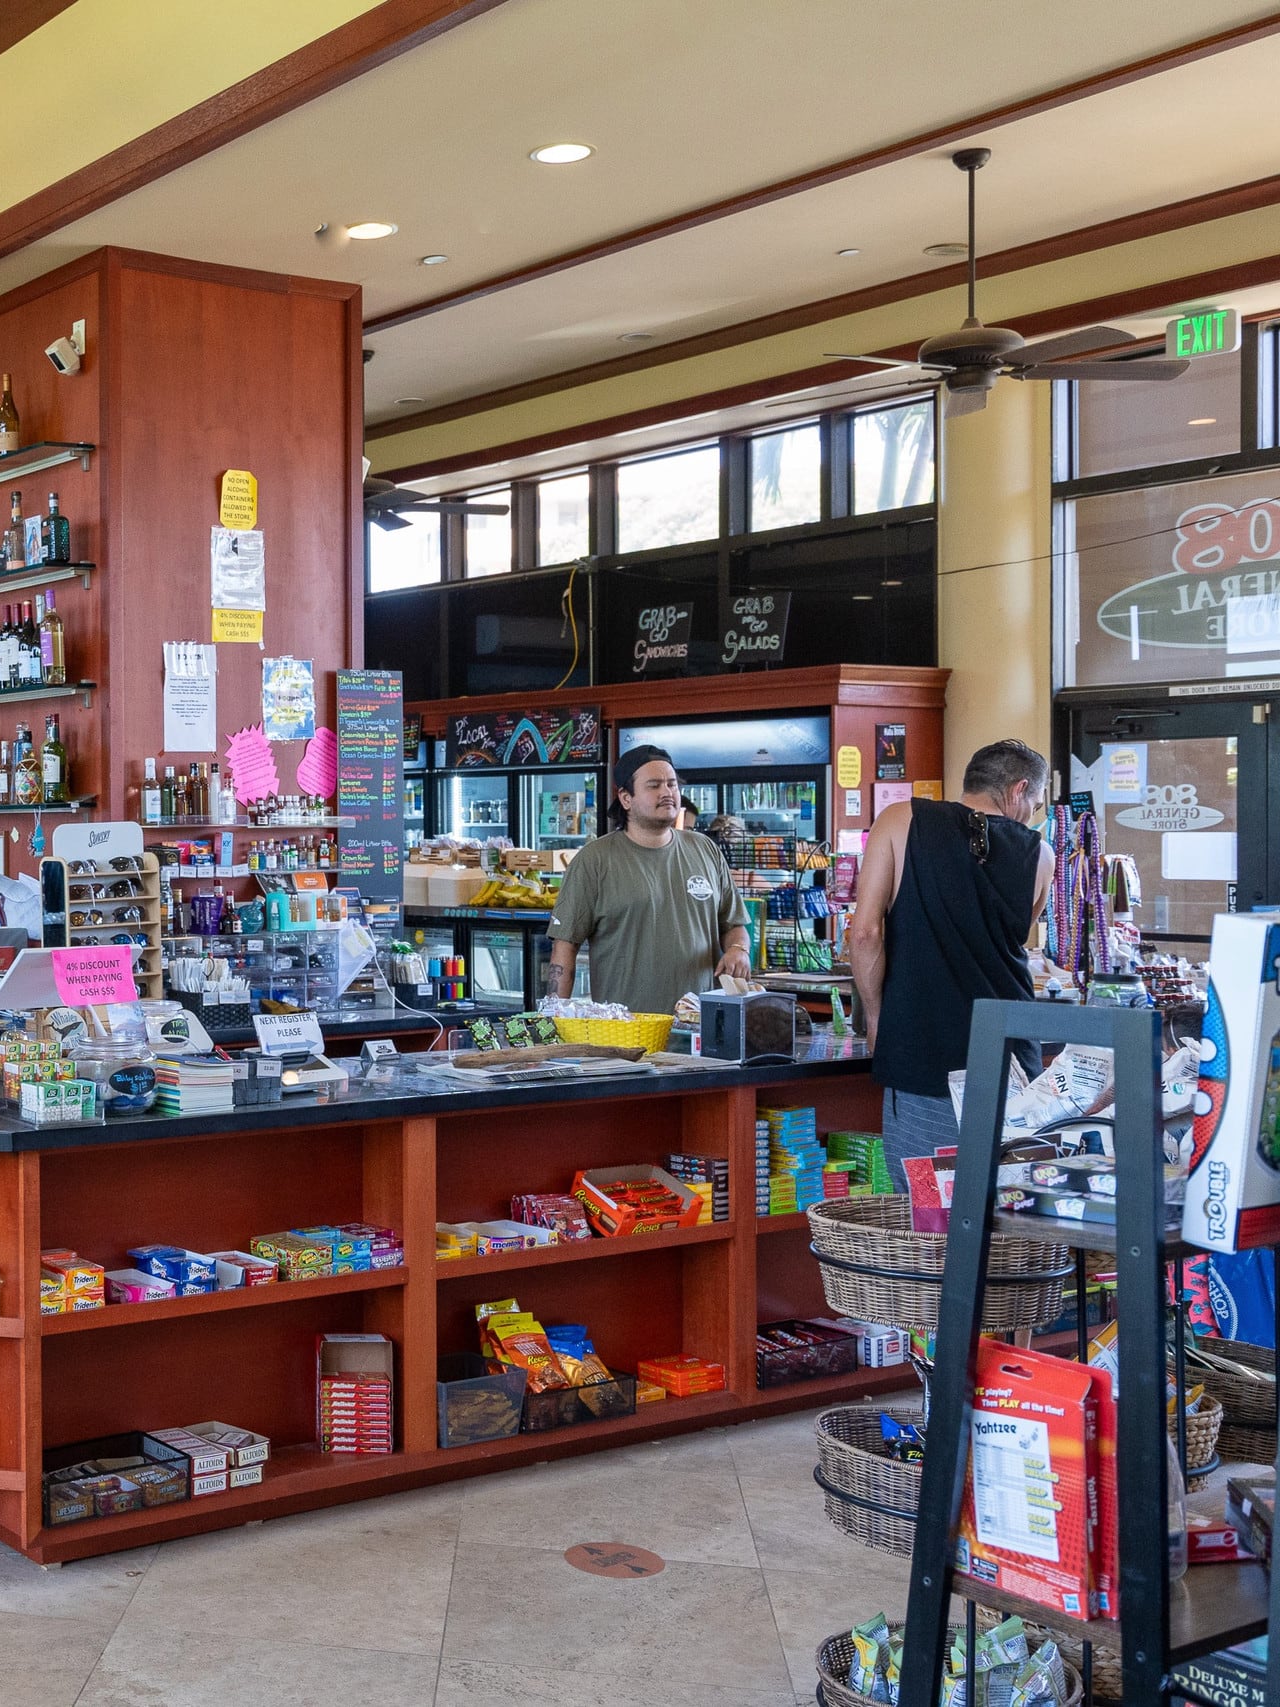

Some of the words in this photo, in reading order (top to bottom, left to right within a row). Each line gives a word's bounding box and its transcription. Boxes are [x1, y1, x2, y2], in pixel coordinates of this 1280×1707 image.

[1177, 312, 1227, 357] EXIT
[227, 486, 249, 494] ALCOHOL
[223, 494, 254, 503] CONTAINERS
[223, 503, 246, 511] ALLOWED
[224, 512, 234, 520] THE
[733, 597, 775, 615] GRAB
[639, 606, 677, 630] GRAB
[750, 621, 768, 633] GO
[649, 628, 669, 642] GO
[722, 630, 780, 664] SALADS
[633, 640, 688, 672] SANDWICHES
[1192, 685, 1205, 694] DOOR
[1208, 684, 1220, 692] MUST
[1222, 682, 1241, 691] REMAIN
[1243, 681, 1269, 690] UNLOCKED
[458, 725, 489, 745] LOCAL
[1229, 886, 1237, 914] PUS
[66, 962, 79, 971] 4%
[80, 959, 121, 970] DISCOUNT
[66, 975, 91, 985] WHEN
[93, 973, 123, 983] PAYING
[80, 988, 100, 997] CASH
[102, 986, 116, 996] $$$
[259, 1014, 277, 1025] NEXT
[278, 1013, 314, 1024] REGISTER,
[277, 1027, 302, 1037] PLEASE
[1073, 1064, 1095, 1074] Nutrition
[1033, 1166, 1058, 1180] UNO
[999, 1190, 1025, 1204] UNO
[1208, 1160, 1227, 1242] TROUBLE
[491, 1240, 521, 1249] mentos
[188, 1265, 211, 1275] Trident
[73, 1275, 97, 1284] Trident
[145, 1291, 169, 1299] Trident
[183, 1286, 206, 1295] Trident
[41, 1306, 60, 1314] ident
[73, 1300, 97, 1309] Trident
[985, 1388, 1013, 1398] playing?
[982, 1399, 998, 1408] Then
[999, 1399, 1019, 1409] PLAY
[1021, 1402, 1031, 1410] all
[1031, 1402, 1043, 1412] the
[1045, 1404, 1065, 1416] time!
[975, 1421, 1017, 1435] Yahtzee
[241, 1448, 266, 1462] ALTOIDS
[197, 1458, 224, 1471] ALTOIDS
[234, 1470, 260, 1483] ALTOIDS
[197, 1480, 224, 1491] ALTOIDS
[1189, 1665, 1249, 1698] DELUXE
